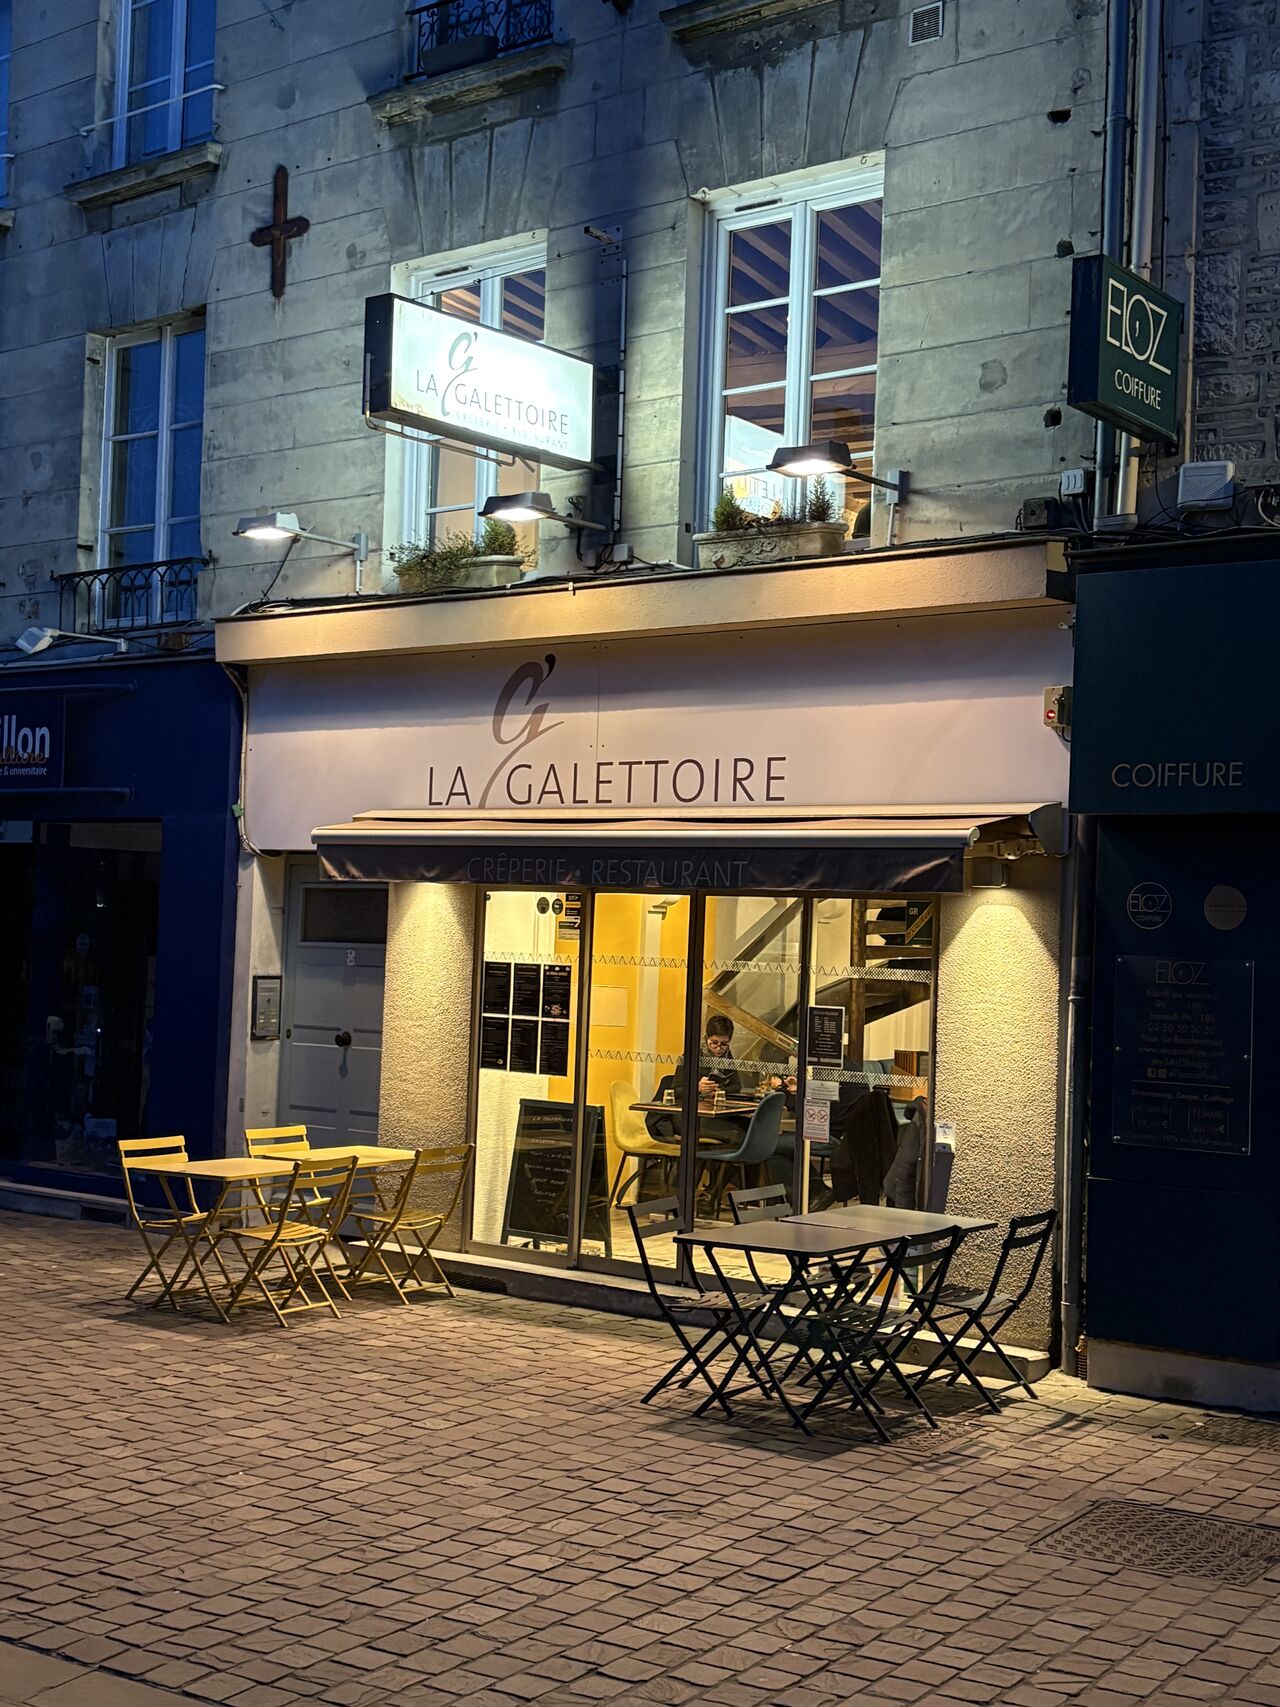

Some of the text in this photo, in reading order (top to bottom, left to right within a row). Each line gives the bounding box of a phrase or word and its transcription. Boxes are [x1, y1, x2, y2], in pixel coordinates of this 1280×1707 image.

[416, 369, 569, 435] LA GALETTOIRE
[1114, 368, 1162, 410] COIFFURE
[0, 714, 50, 758] llon
[9, 766, 48, 776] universitaire
[428, 756, 787, 806] LA GALETTOIRE
[1111, 761, 1244, 788] COIFFURE
[467, 852, 749, 887] CRÊPERIE RESTAURANT
